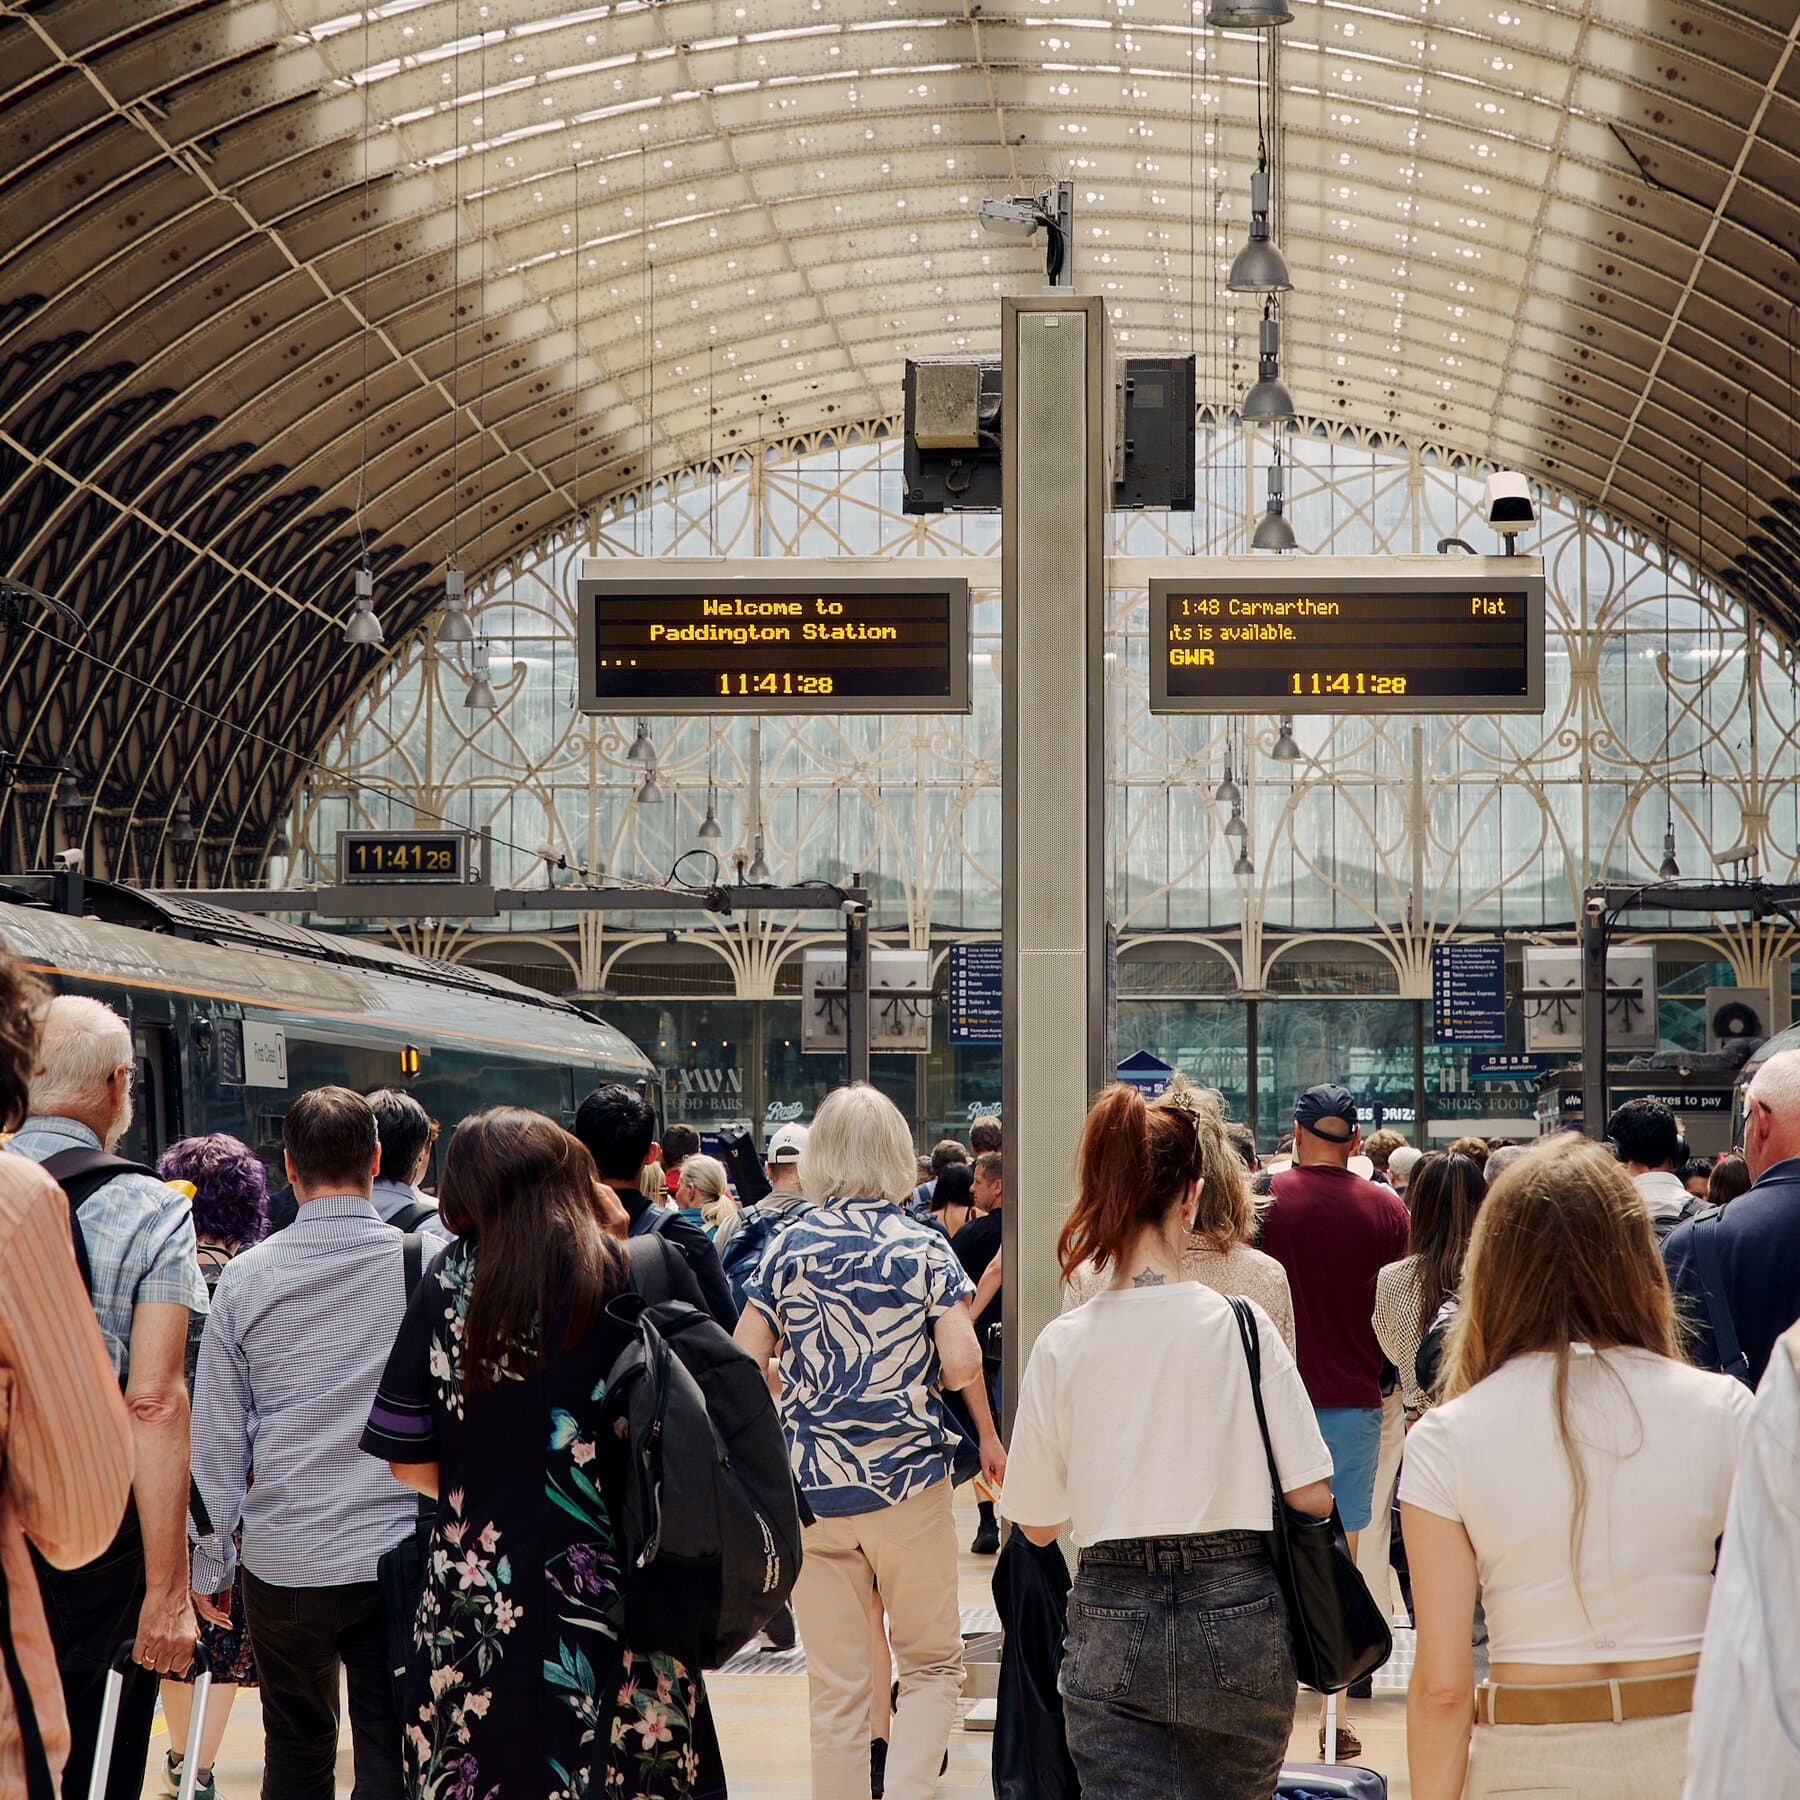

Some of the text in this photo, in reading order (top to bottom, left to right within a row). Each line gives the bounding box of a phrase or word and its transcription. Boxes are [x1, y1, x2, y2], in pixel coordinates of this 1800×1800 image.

[703, 599, 843, 616] Welcome to
[1228, 599, 1339, 616] Carmarthen
[1471, 597, 1506, 615] Plat
[650, 624, 897, 644] Paddington Station
[1198, 624, 1213, 641] is
[1220, 624, 1297, 641] available.
[1169, 649, 1215, 665] GWR
[720, 673, 833, 694] 11:41:28
[1292, 673, 1406, 694] 11:41:28
[356, 845, 452, 870] 11:41 28
[667, 1097, 744, 1110] OOD BARS
[1438, 1097, 1529, 1111] SHOPS FOOD
[1685, 1095, 1698, 1106] to
[1701, 1096, 1722, 1108] pay
